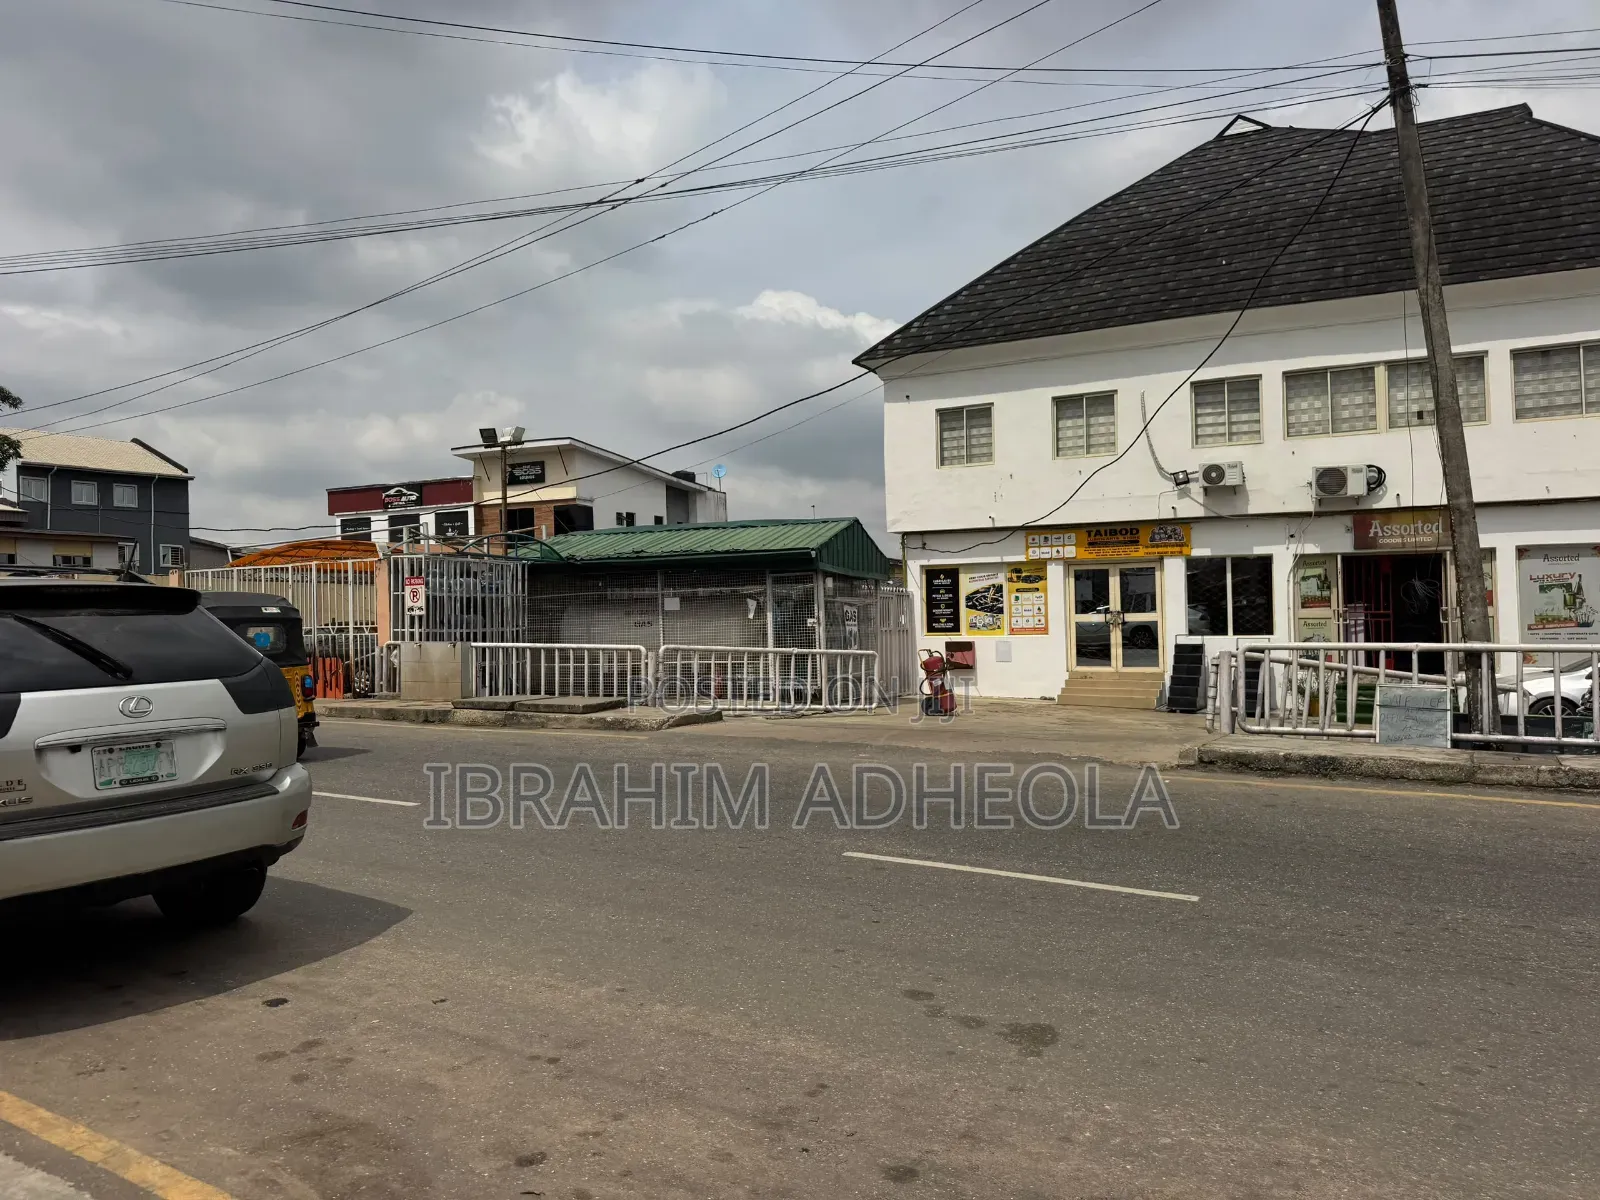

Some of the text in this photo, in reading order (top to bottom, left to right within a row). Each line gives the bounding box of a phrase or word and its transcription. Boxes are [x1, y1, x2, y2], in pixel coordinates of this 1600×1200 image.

[1368, 516, 1443, 537] Assorted
[1086, 527, 1140, 538] TAIBOD
[1542, 552, 1581, 563] Assorted
[844, 609, 857, 622] GAS
[1302, 620, 1327, 628] Assorted
[230, 767, 249, 776] RX
